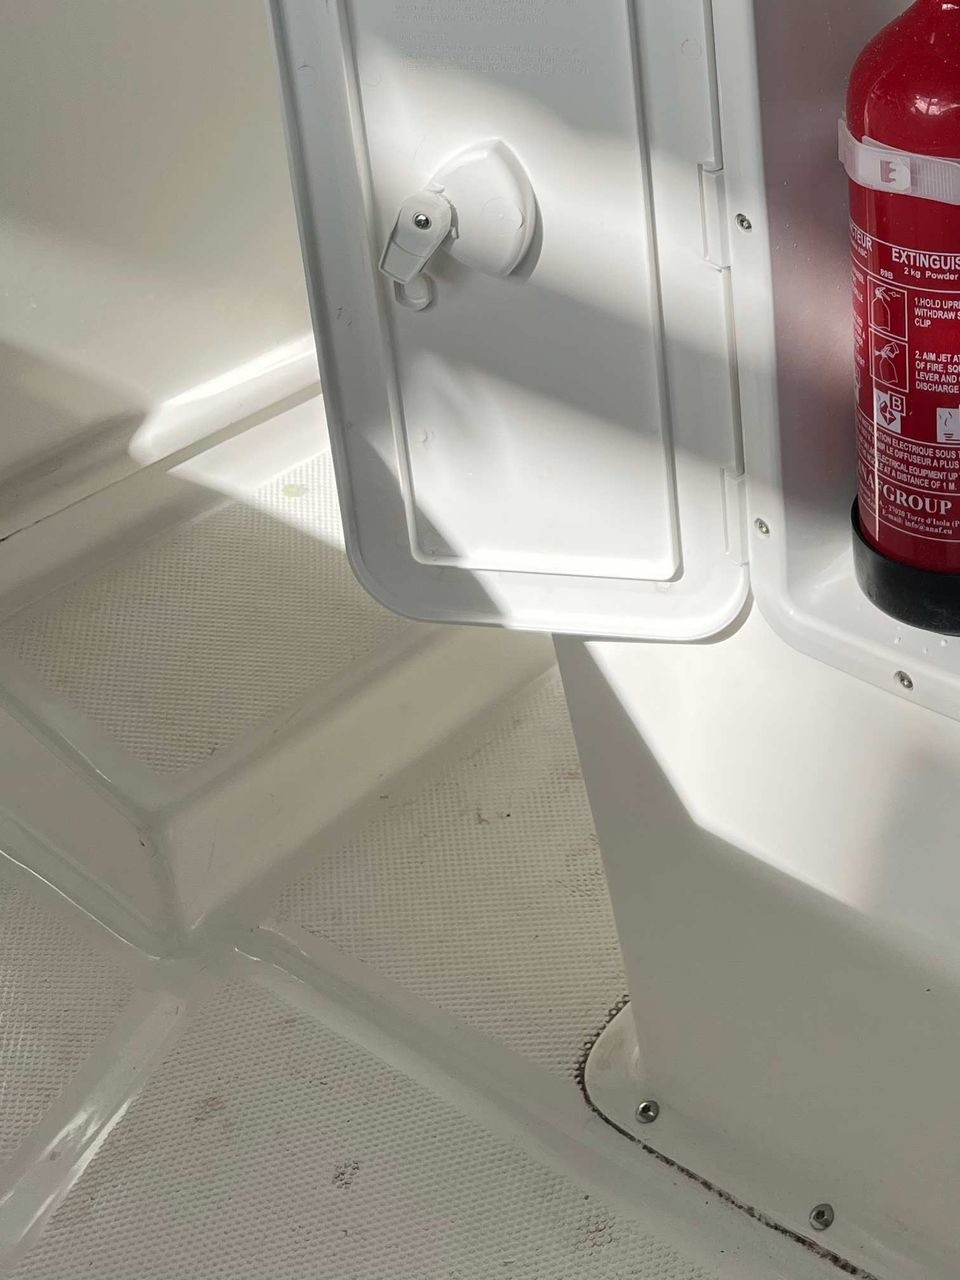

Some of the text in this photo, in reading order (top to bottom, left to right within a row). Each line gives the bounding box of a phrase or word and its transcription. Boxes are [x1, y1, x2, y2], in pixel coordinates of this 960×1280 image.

[903, 266, 909, 275] 2
[910, 268, 921, 279] kg
[925, 270, 959, 280] Powder
[914, 307, 956, 320] WITHDRAW
[914, 317, 931, 328] CLIP
[922, 351, 937, 361] AIM
[938, 353, 952, 363] JET
[915, 360, 926, 370] OF
[915, 370, 940, 382] LEVER
[940, 374, 958, 384] AND
[915, 380, 960, 394] DISCHARGE
[891, 397, 903, 411] B
[891, 437, 934, 458] ELECTRIQUE
[934, 449, 957, 459] SOUS
[885, 445, 895, 457] LE
[894, 449, 931, 468] DIFFUSEUR
[932, 459, 940, 468] A
[939, 460, 960, 470] PLUS
[891, 468, 897, 478] A
[896, 470, 930, 488] DISTANCE
[930, 478, 942, 488] OF
[942, 480, 947, 489] 1
[908, 465, 948, 480] EQUIPMENT
[947, 472, 959, 481] UP
